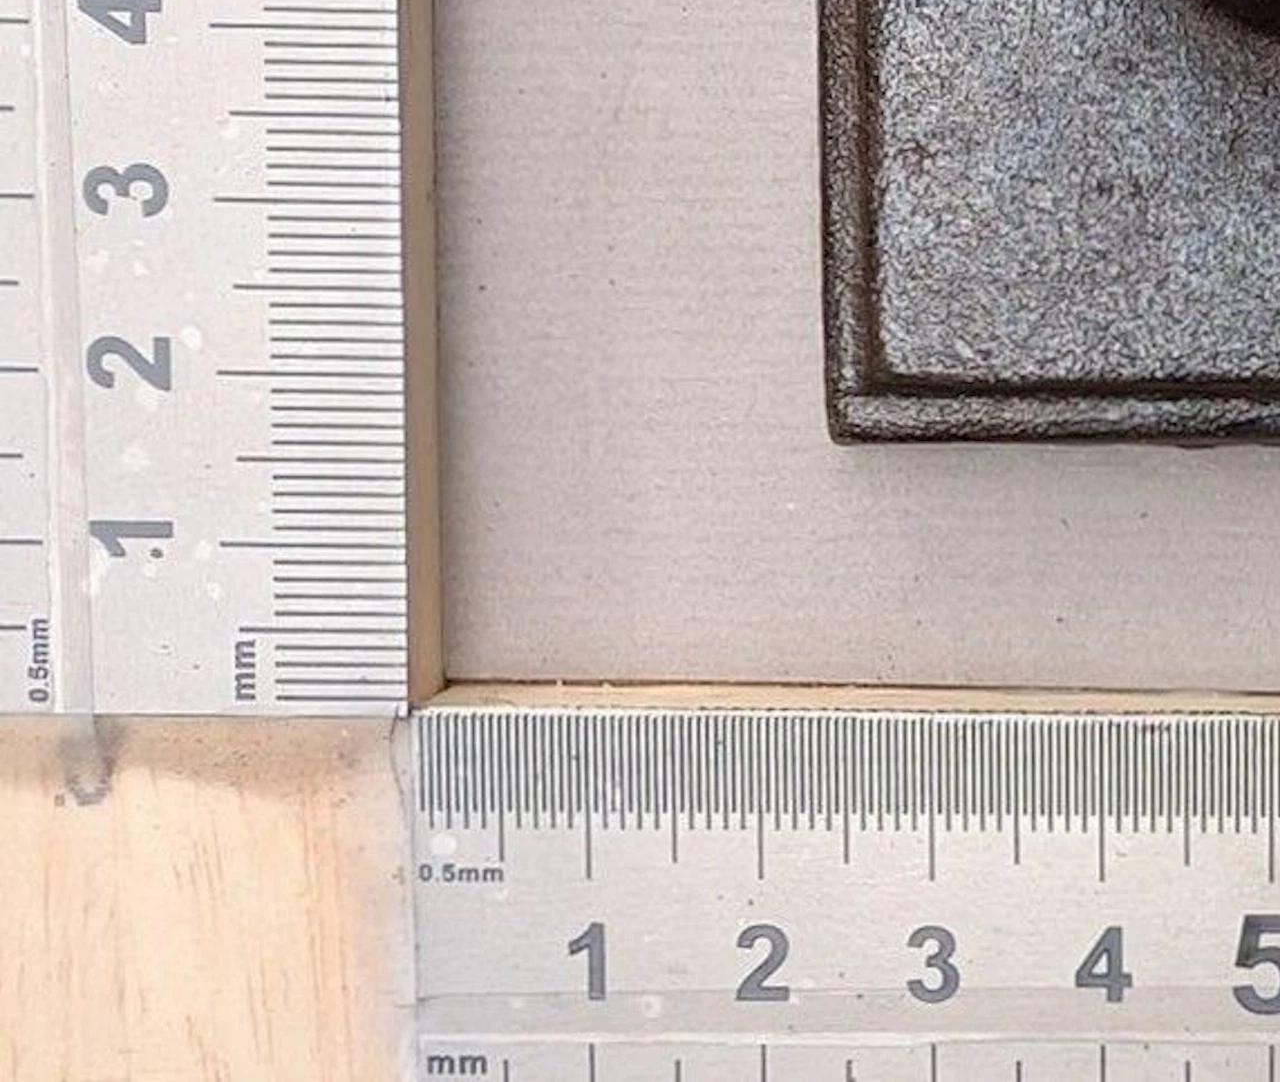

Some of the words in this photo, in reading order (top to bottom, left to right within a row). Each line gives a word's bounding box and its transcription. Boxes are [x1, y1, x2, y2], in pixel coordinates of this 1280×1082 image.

[83, 163, 169, 217] 3
[87, 336, 171, 392] 2
[88, 520, 174, 558] 1
[28, 618, 50, 703] 0.5mm
[235, 639, 256, 701] mm
[419, 864, 504, 883] 0.5mm
[568, 922, 606, 1001] 1
[735, 924, 790, 1002] 2
[907, 926, 960, 1004] 3
[1075, 927, 1132, 1003] 4
[426, 1054, 488, 1076] mm
